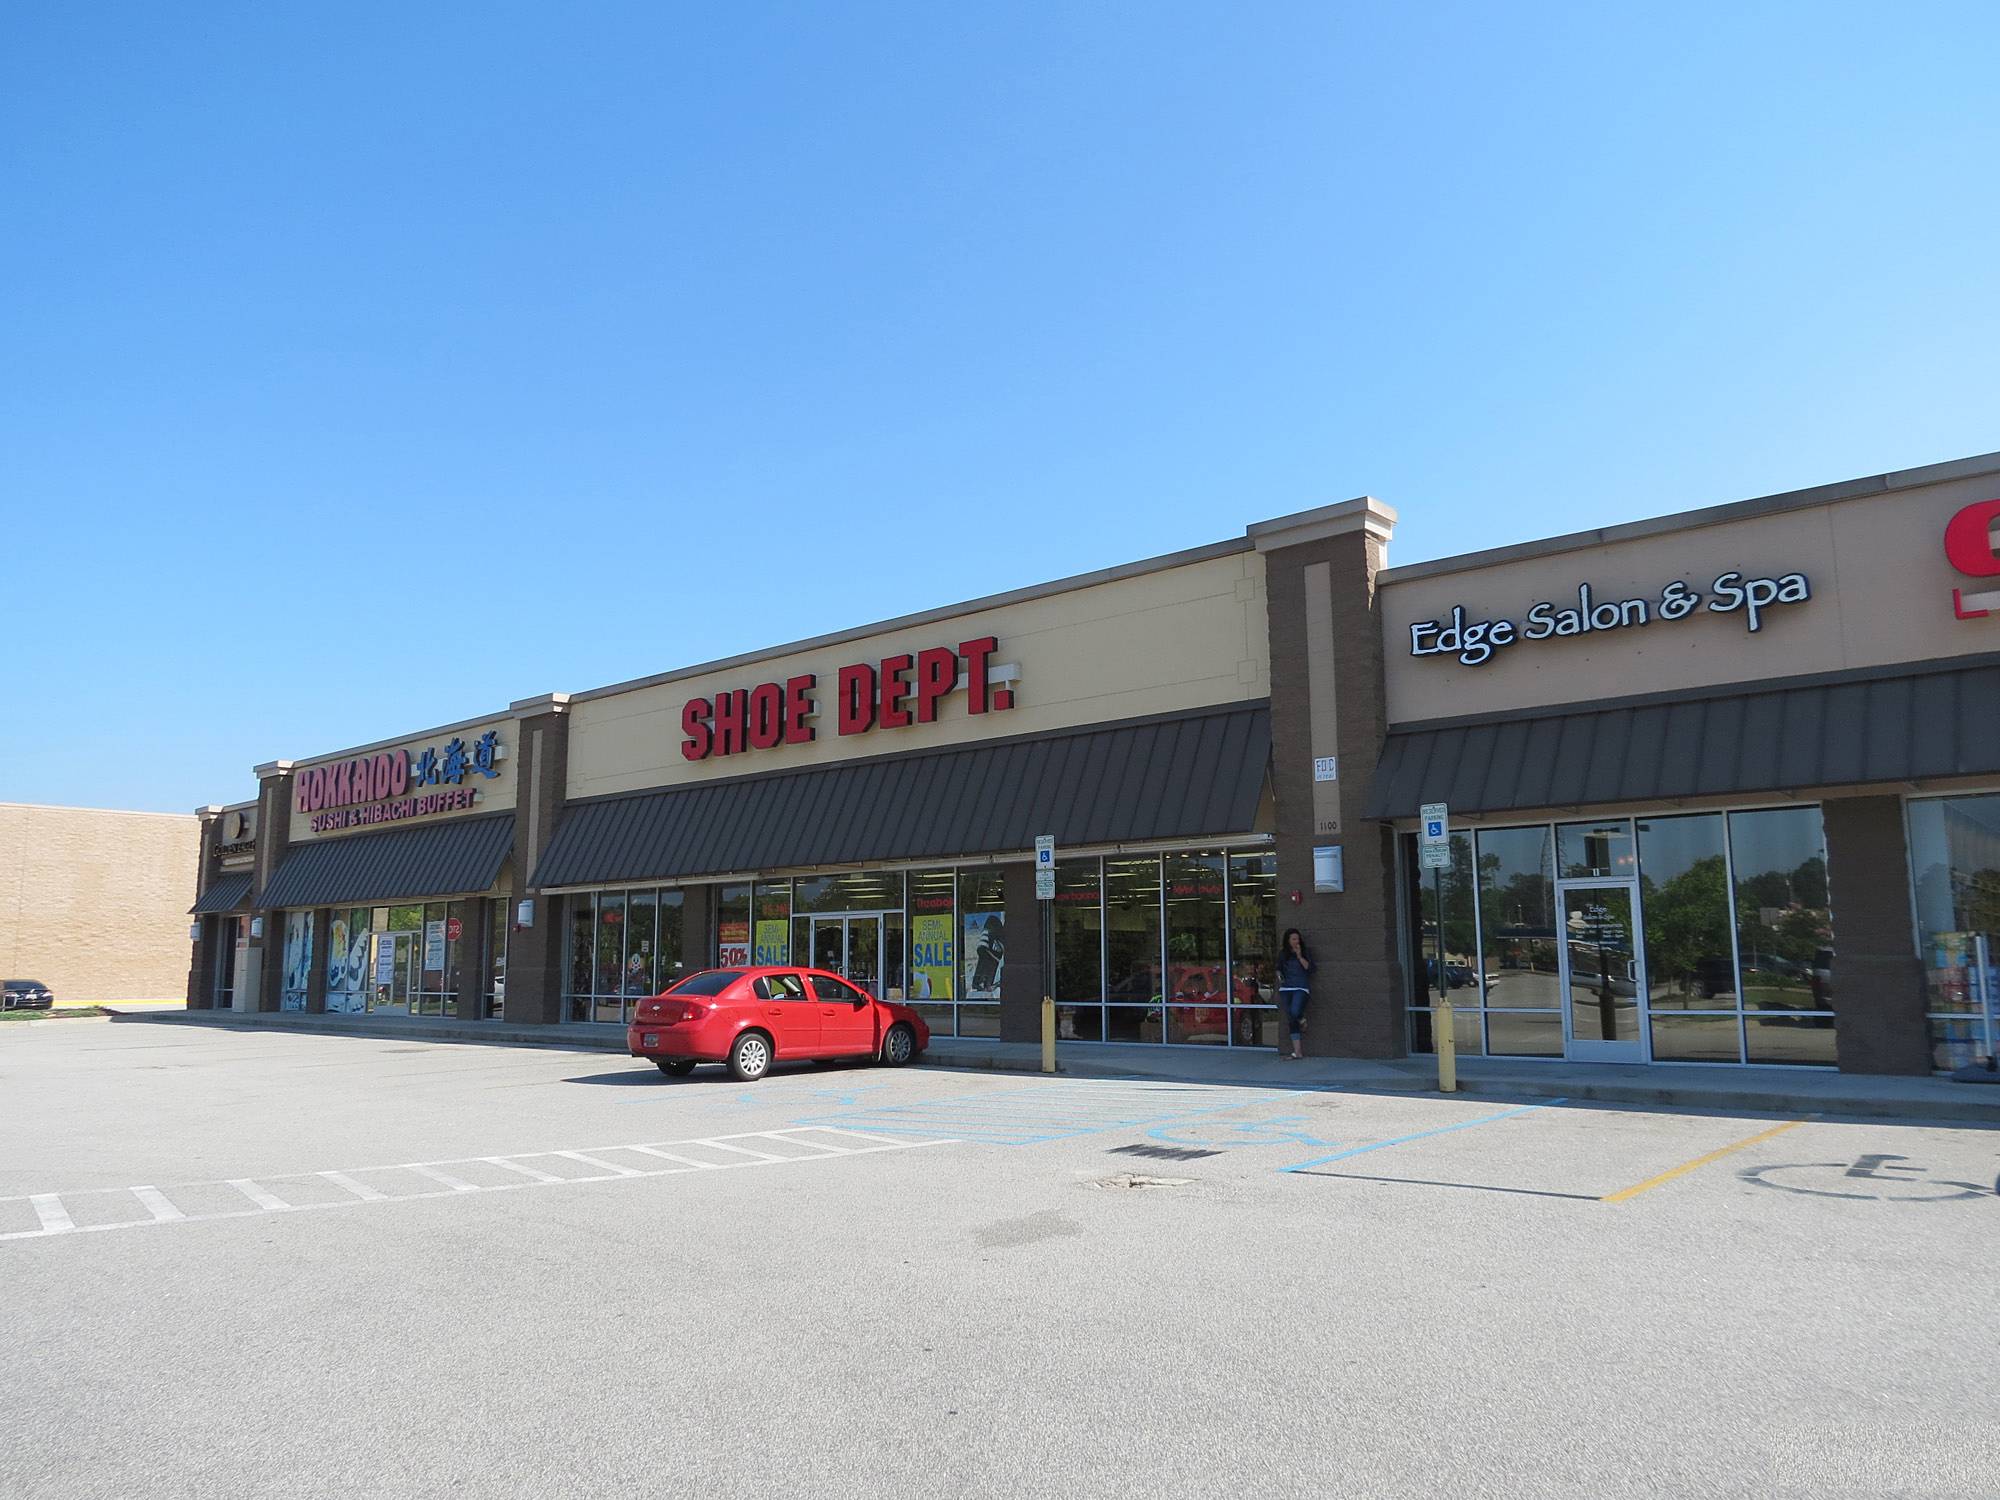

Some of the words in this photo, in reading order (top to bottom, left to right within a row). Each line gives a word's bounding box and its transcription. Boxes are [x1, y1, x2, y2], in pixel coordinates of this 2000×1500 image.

[1409, 604, 1518, 667] Edge
[1523, 582, 1649, 641] Salon
[1658, 579, 1699, 622] &
[1708, 570, 1812, 633] Spa
[681, 673, 817, 762] SHOE
[837, 635, 1016, 737] DEPT.
[295, 749, 411, 814] HOKKAIDO
[415, 729, 500, 788] 北海道
[309, 811, 348, 833] SUSHI
[348, 808, 362, 826] &
[362, 797, 415, 825] HIBACHI
[417, 787, 477, 816] BUFFET
[1320, 821, 1337, 831] 1100
[720, 946, 749, 968] 50%
[757, 943, 788, 966] SALE
[914, 942, 953, 968] SALE
